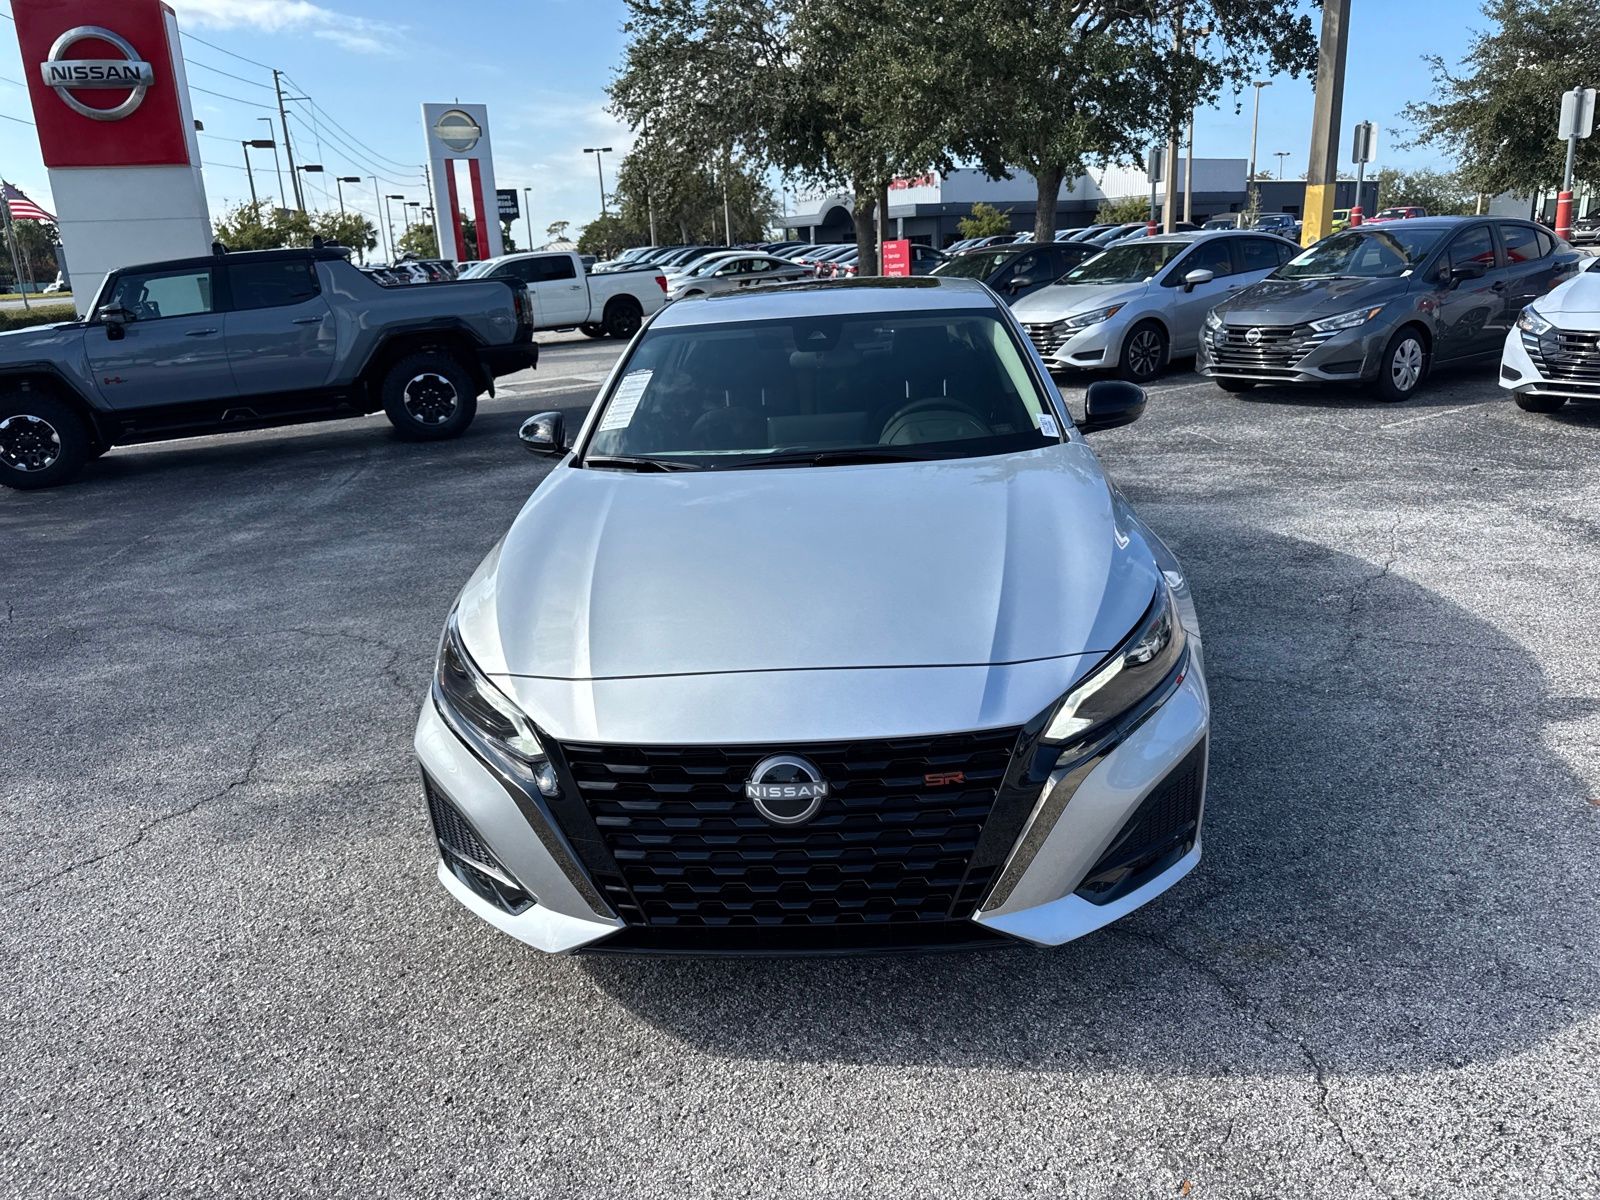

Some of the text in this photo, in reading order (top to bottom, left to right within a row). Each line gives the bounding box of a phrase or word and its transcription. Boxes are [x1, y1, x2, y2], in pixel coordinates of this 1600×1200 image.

[50, 65, 141, 81] NISSAN
[925, 771, 965, 786] SR
[747, 783, 827, 798] NISSAN
